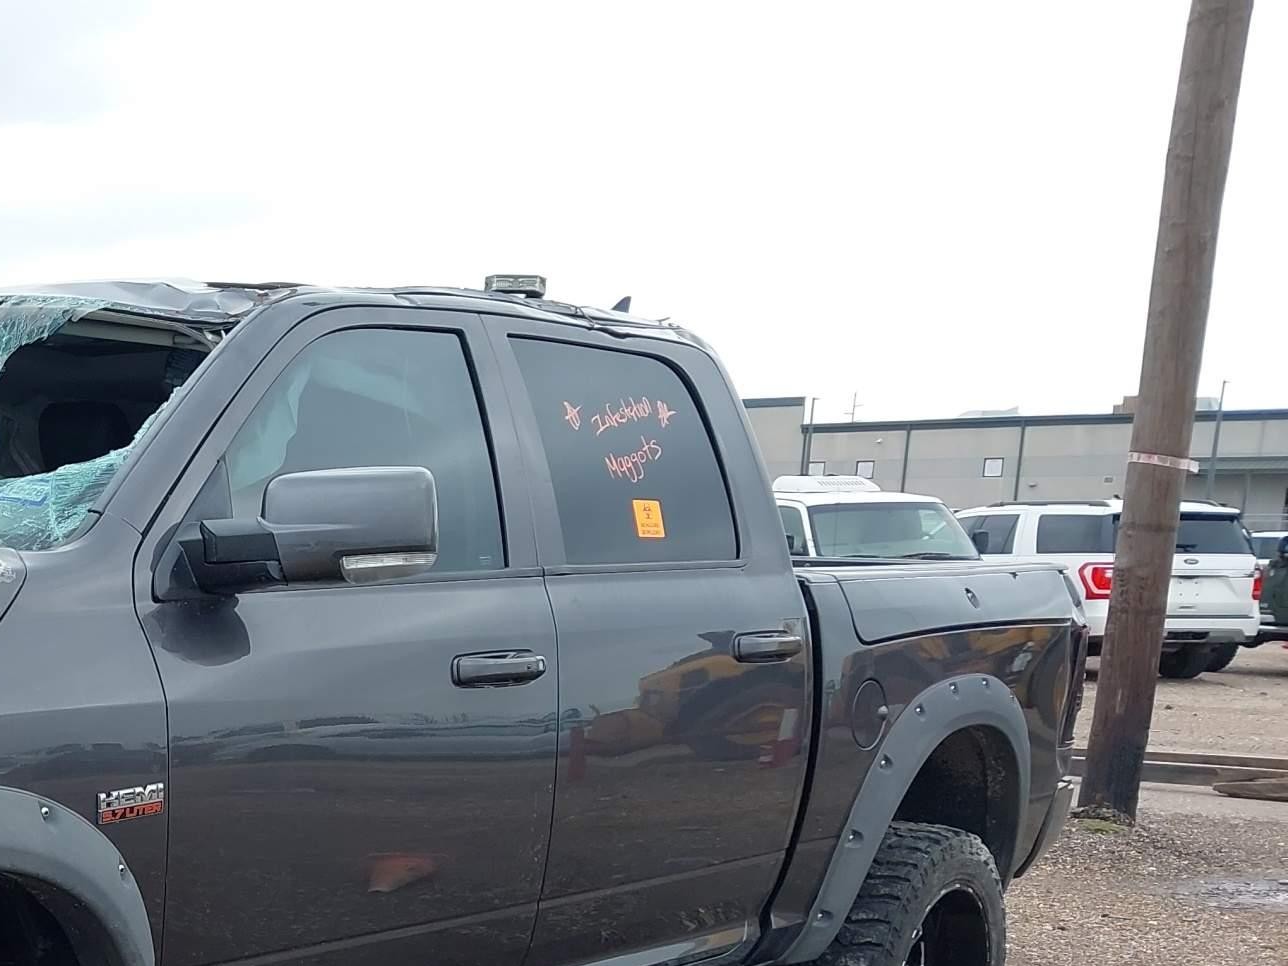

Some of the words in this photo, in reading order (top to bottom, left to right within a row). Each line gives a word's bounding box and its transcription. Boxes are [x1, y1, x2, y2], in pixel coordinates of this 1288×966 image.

[604, 435, 662, 483] Maggots
[97, 782, 164, 810] HEMI
[102, 809, 123, 822] 5.7
[125, 803, 162, 818] LITER
